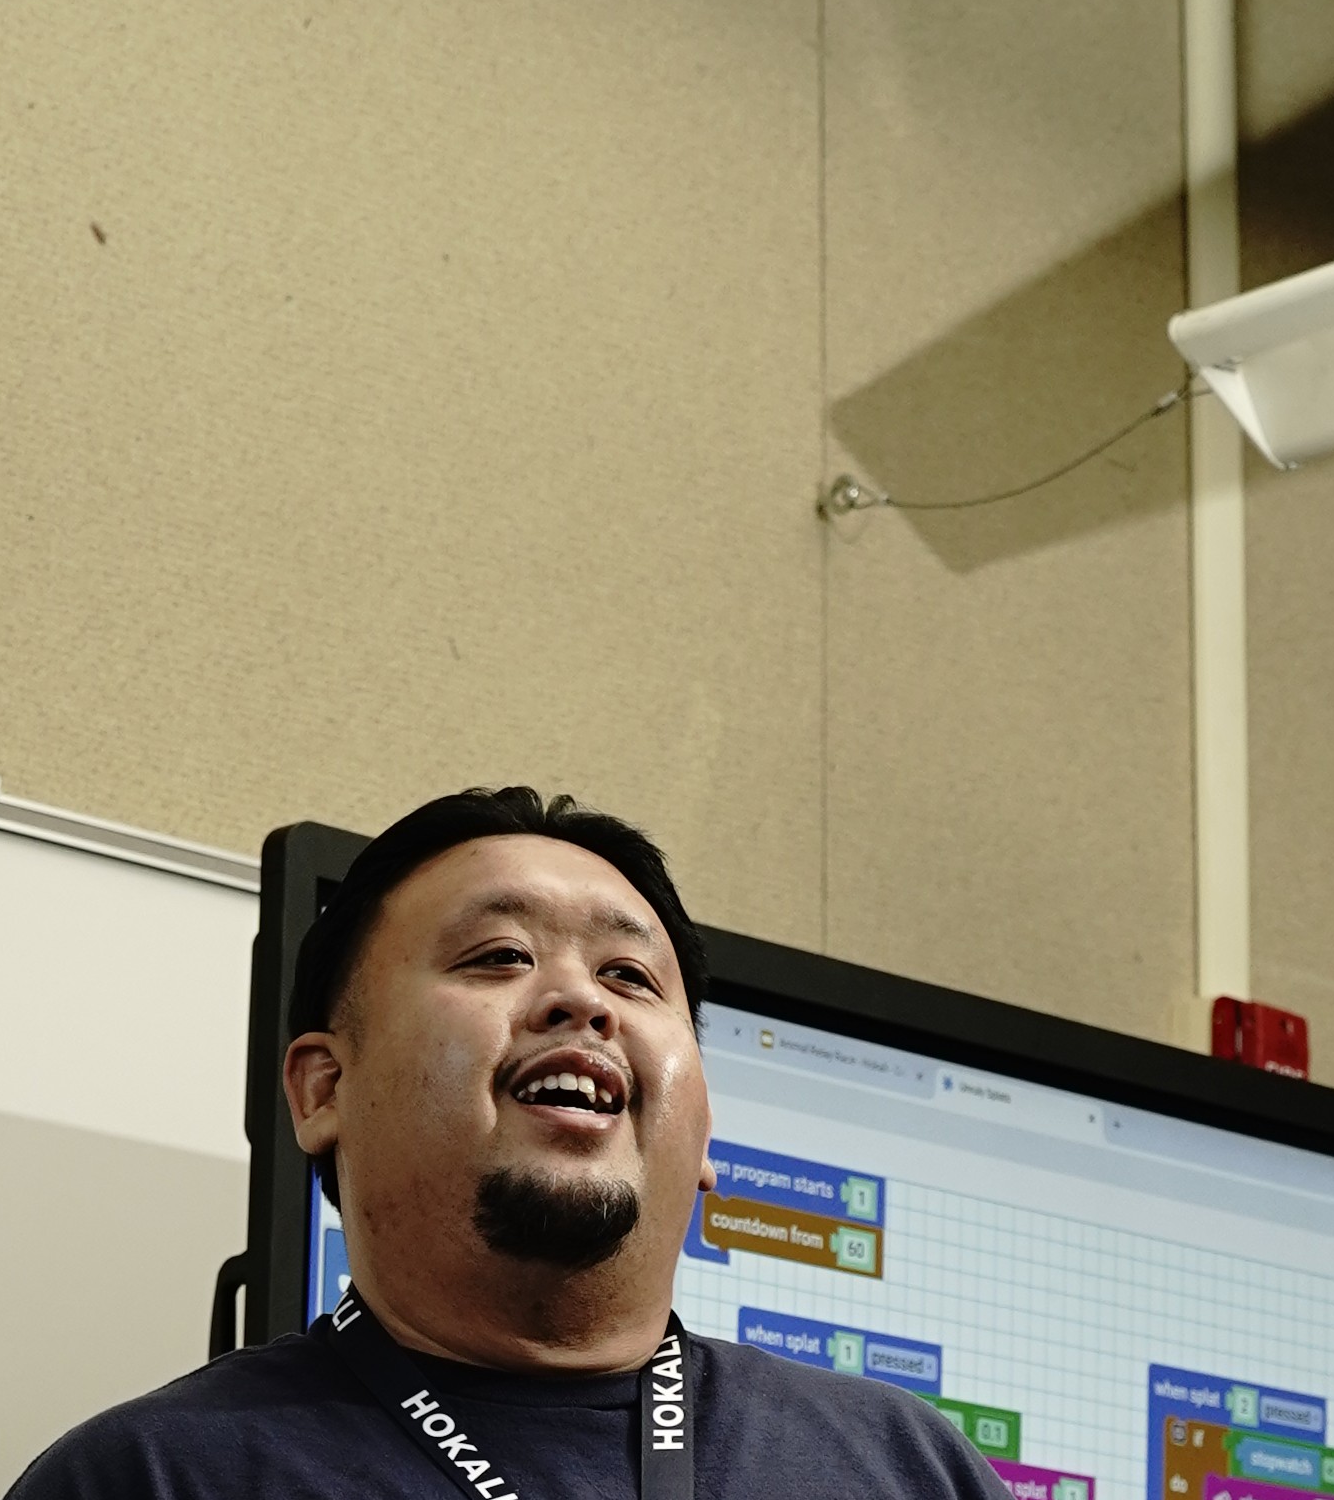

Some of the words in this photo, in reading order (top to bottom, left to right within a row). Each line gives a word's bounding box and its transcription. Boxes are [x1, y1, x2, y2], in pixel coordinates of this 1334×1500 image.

[732, 1165, 791, 1190] program
[793, 1176, 834, 1199] starts
[710, 1211, 788, 1240] countdown
[790, 1225, 824, 1249] from
[847, 1240, 865, 1259] 60
[745, 1325, 783, 1347] when
[786, 1334, 820, 1355] splat
[871, 1350, 925, 1375] pressed
[1154, 1382, 1188, 1401] when
[1189, 1387, 1220, 1407] splat
[1263, 1404, 1312, 1426] pressed
[1249, 1449, 1314, 1476] stopwatch
